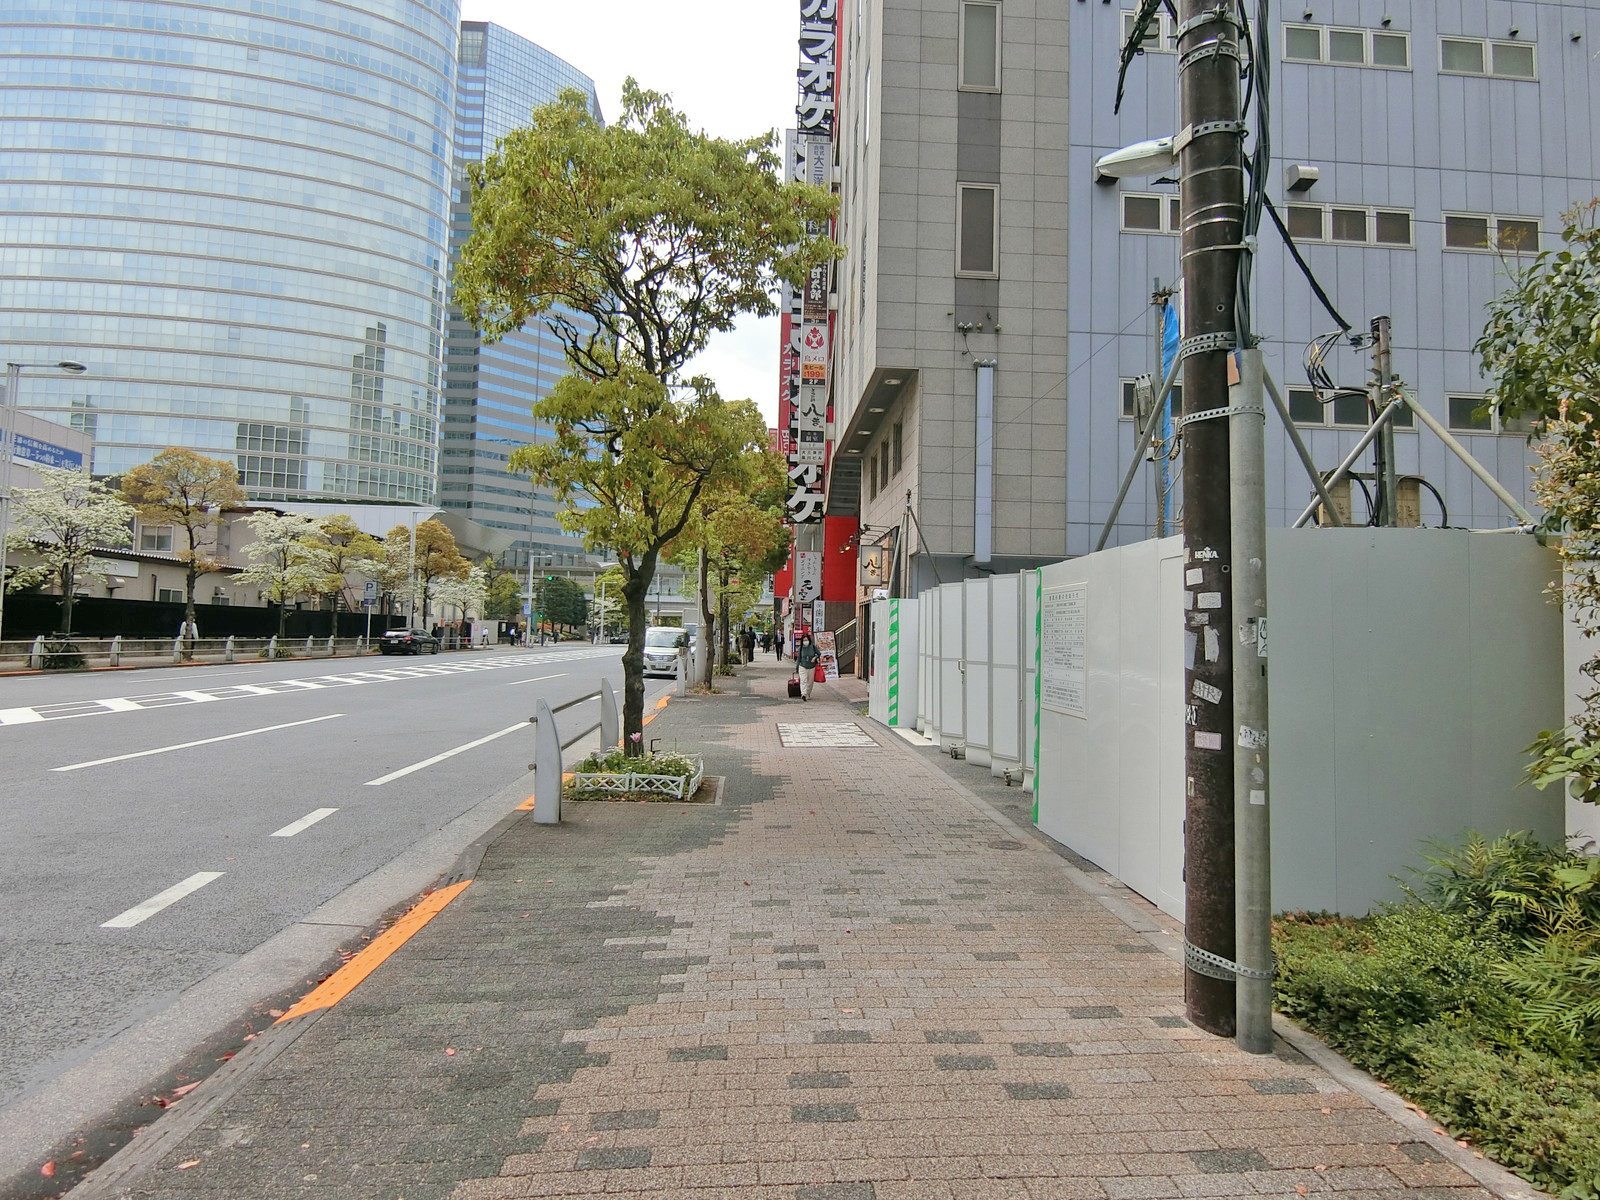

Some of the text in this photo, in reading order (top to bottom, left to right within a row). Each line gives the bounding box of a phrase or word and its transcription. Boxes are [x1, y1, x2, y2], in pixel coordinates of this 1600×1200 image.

[810, 266, 822, 301] 甘太郎
[365, 582, 374, 592] P
